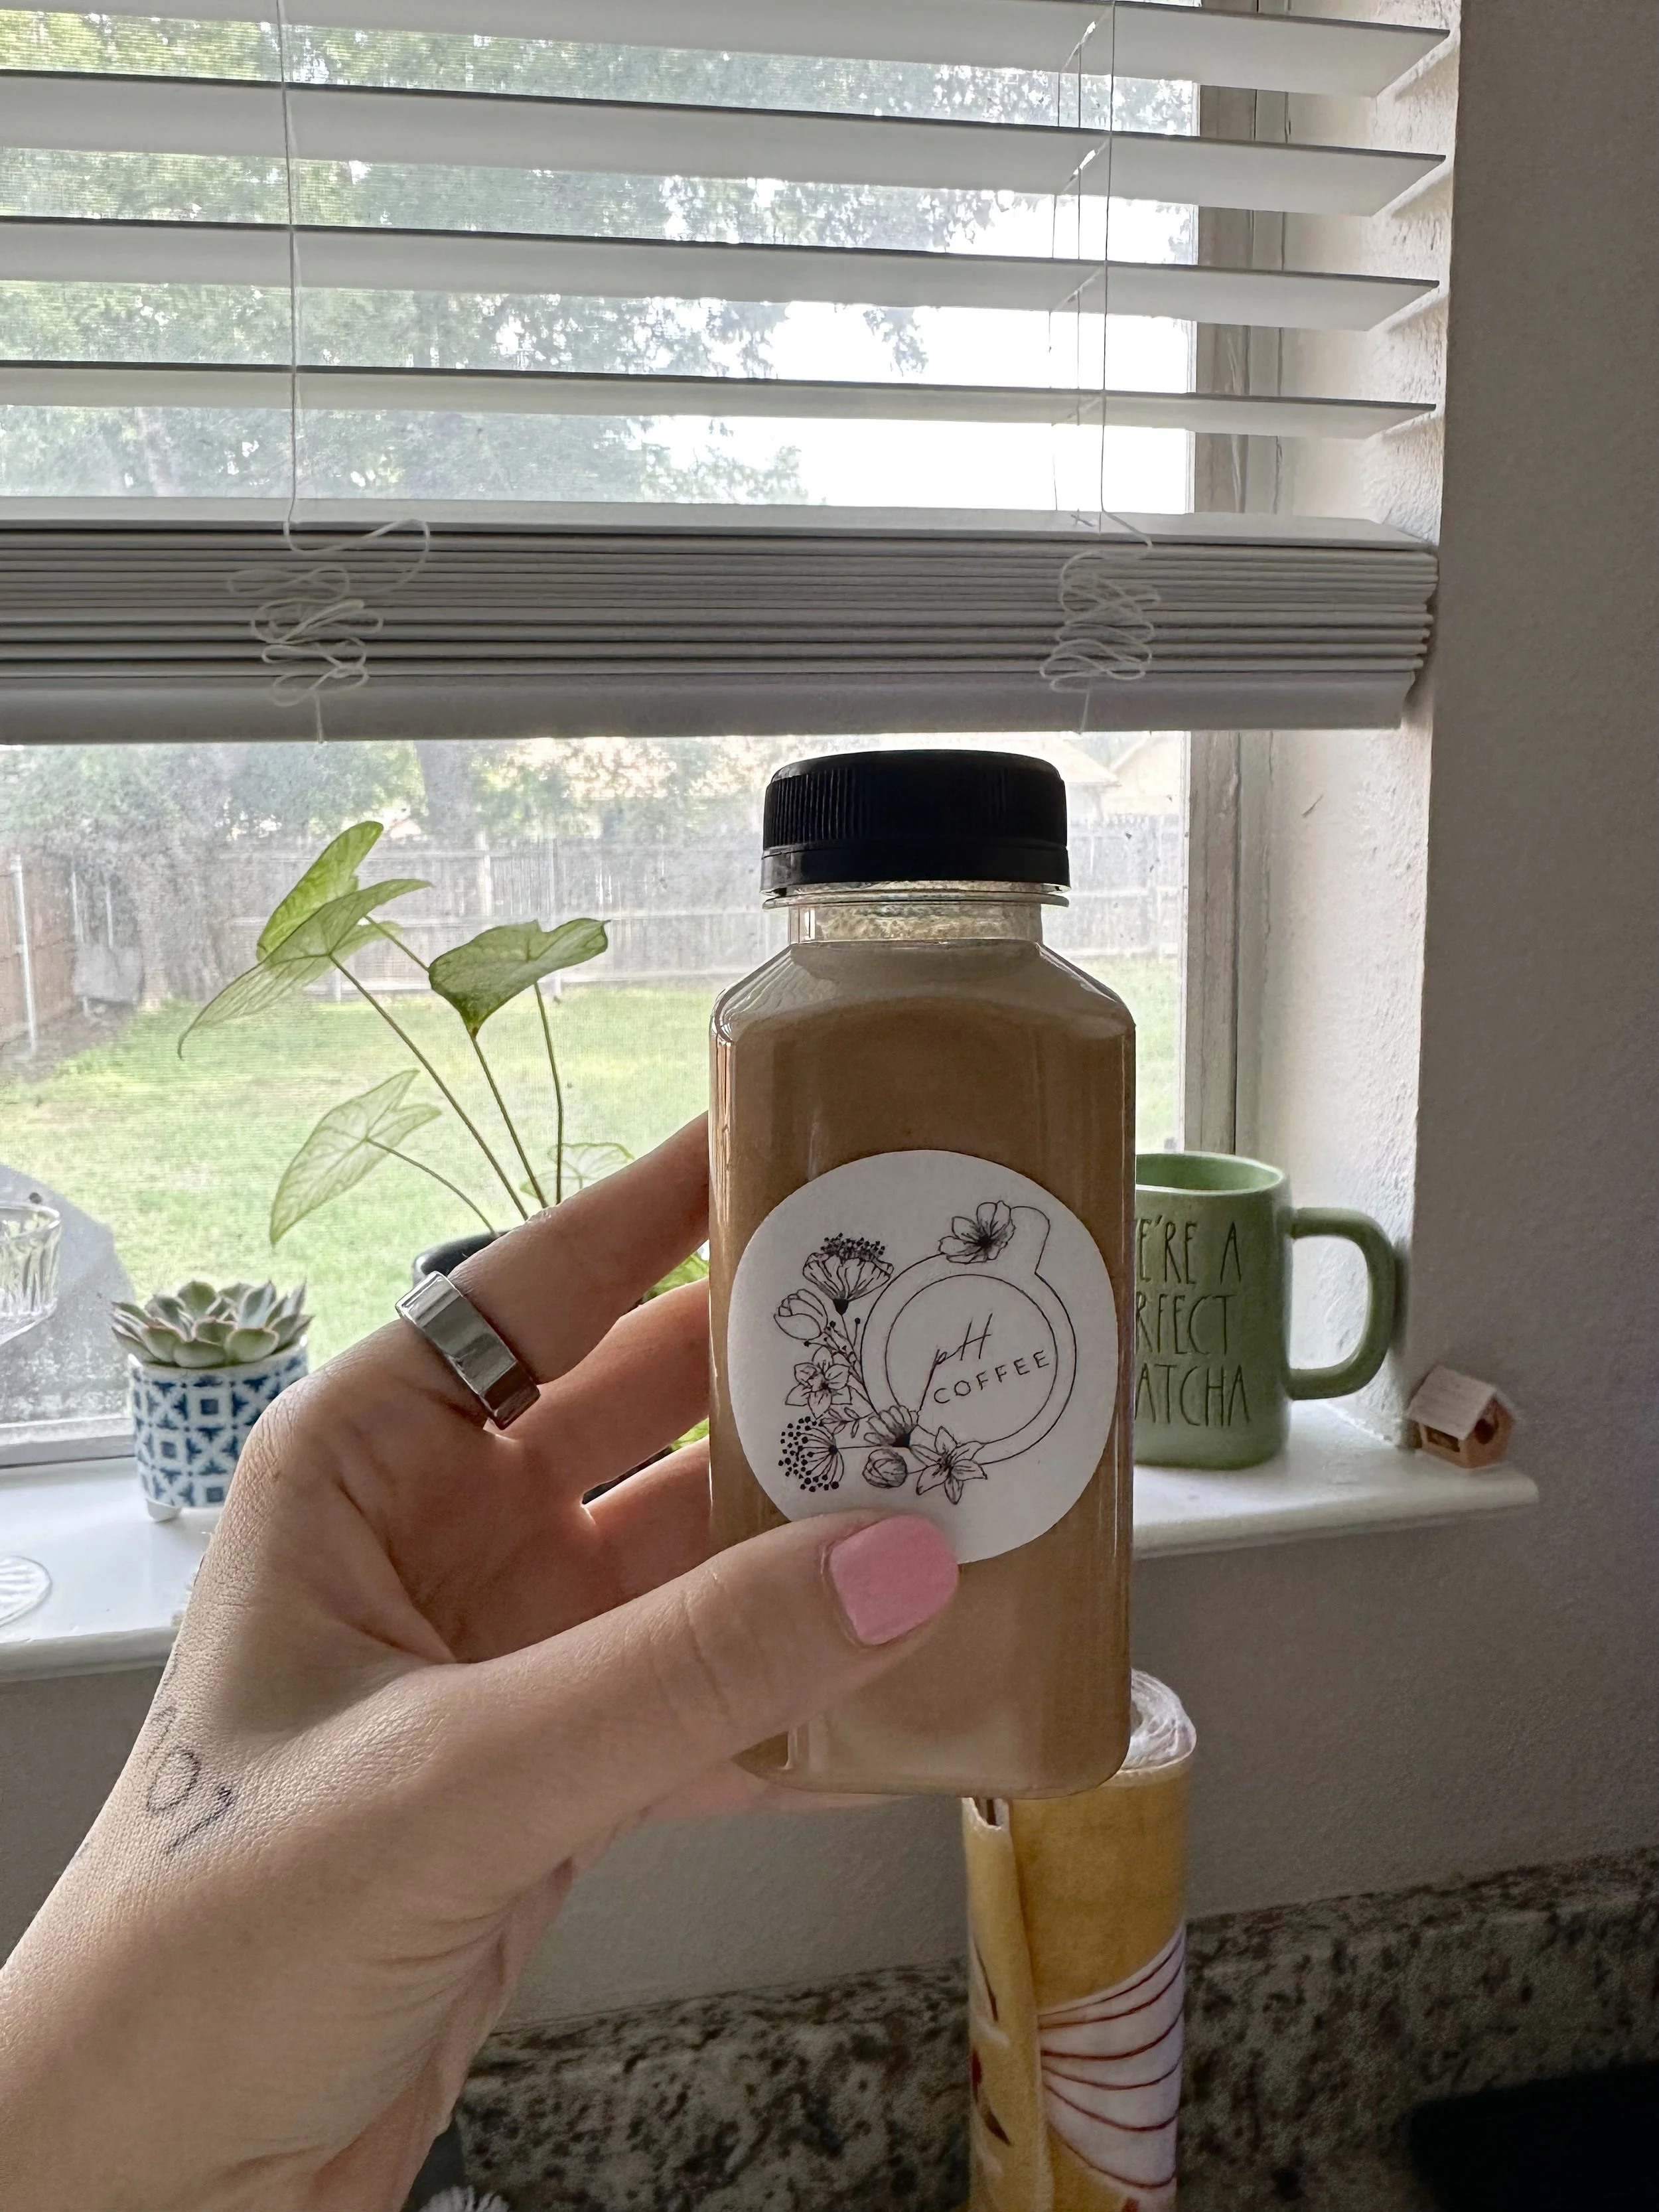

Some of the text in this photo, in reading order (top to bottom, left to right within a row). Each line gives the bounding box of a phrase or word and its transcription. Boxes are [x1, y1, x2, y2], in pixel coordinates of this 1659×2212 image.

[1136, 1214, 1242, 1285] E'RE A
[1134, 1291, 1236, 1355] RFECT
[933, 1350, 1050, 1404] COFFEE
[1134, 1363, 1251, 1428] ATCHA
